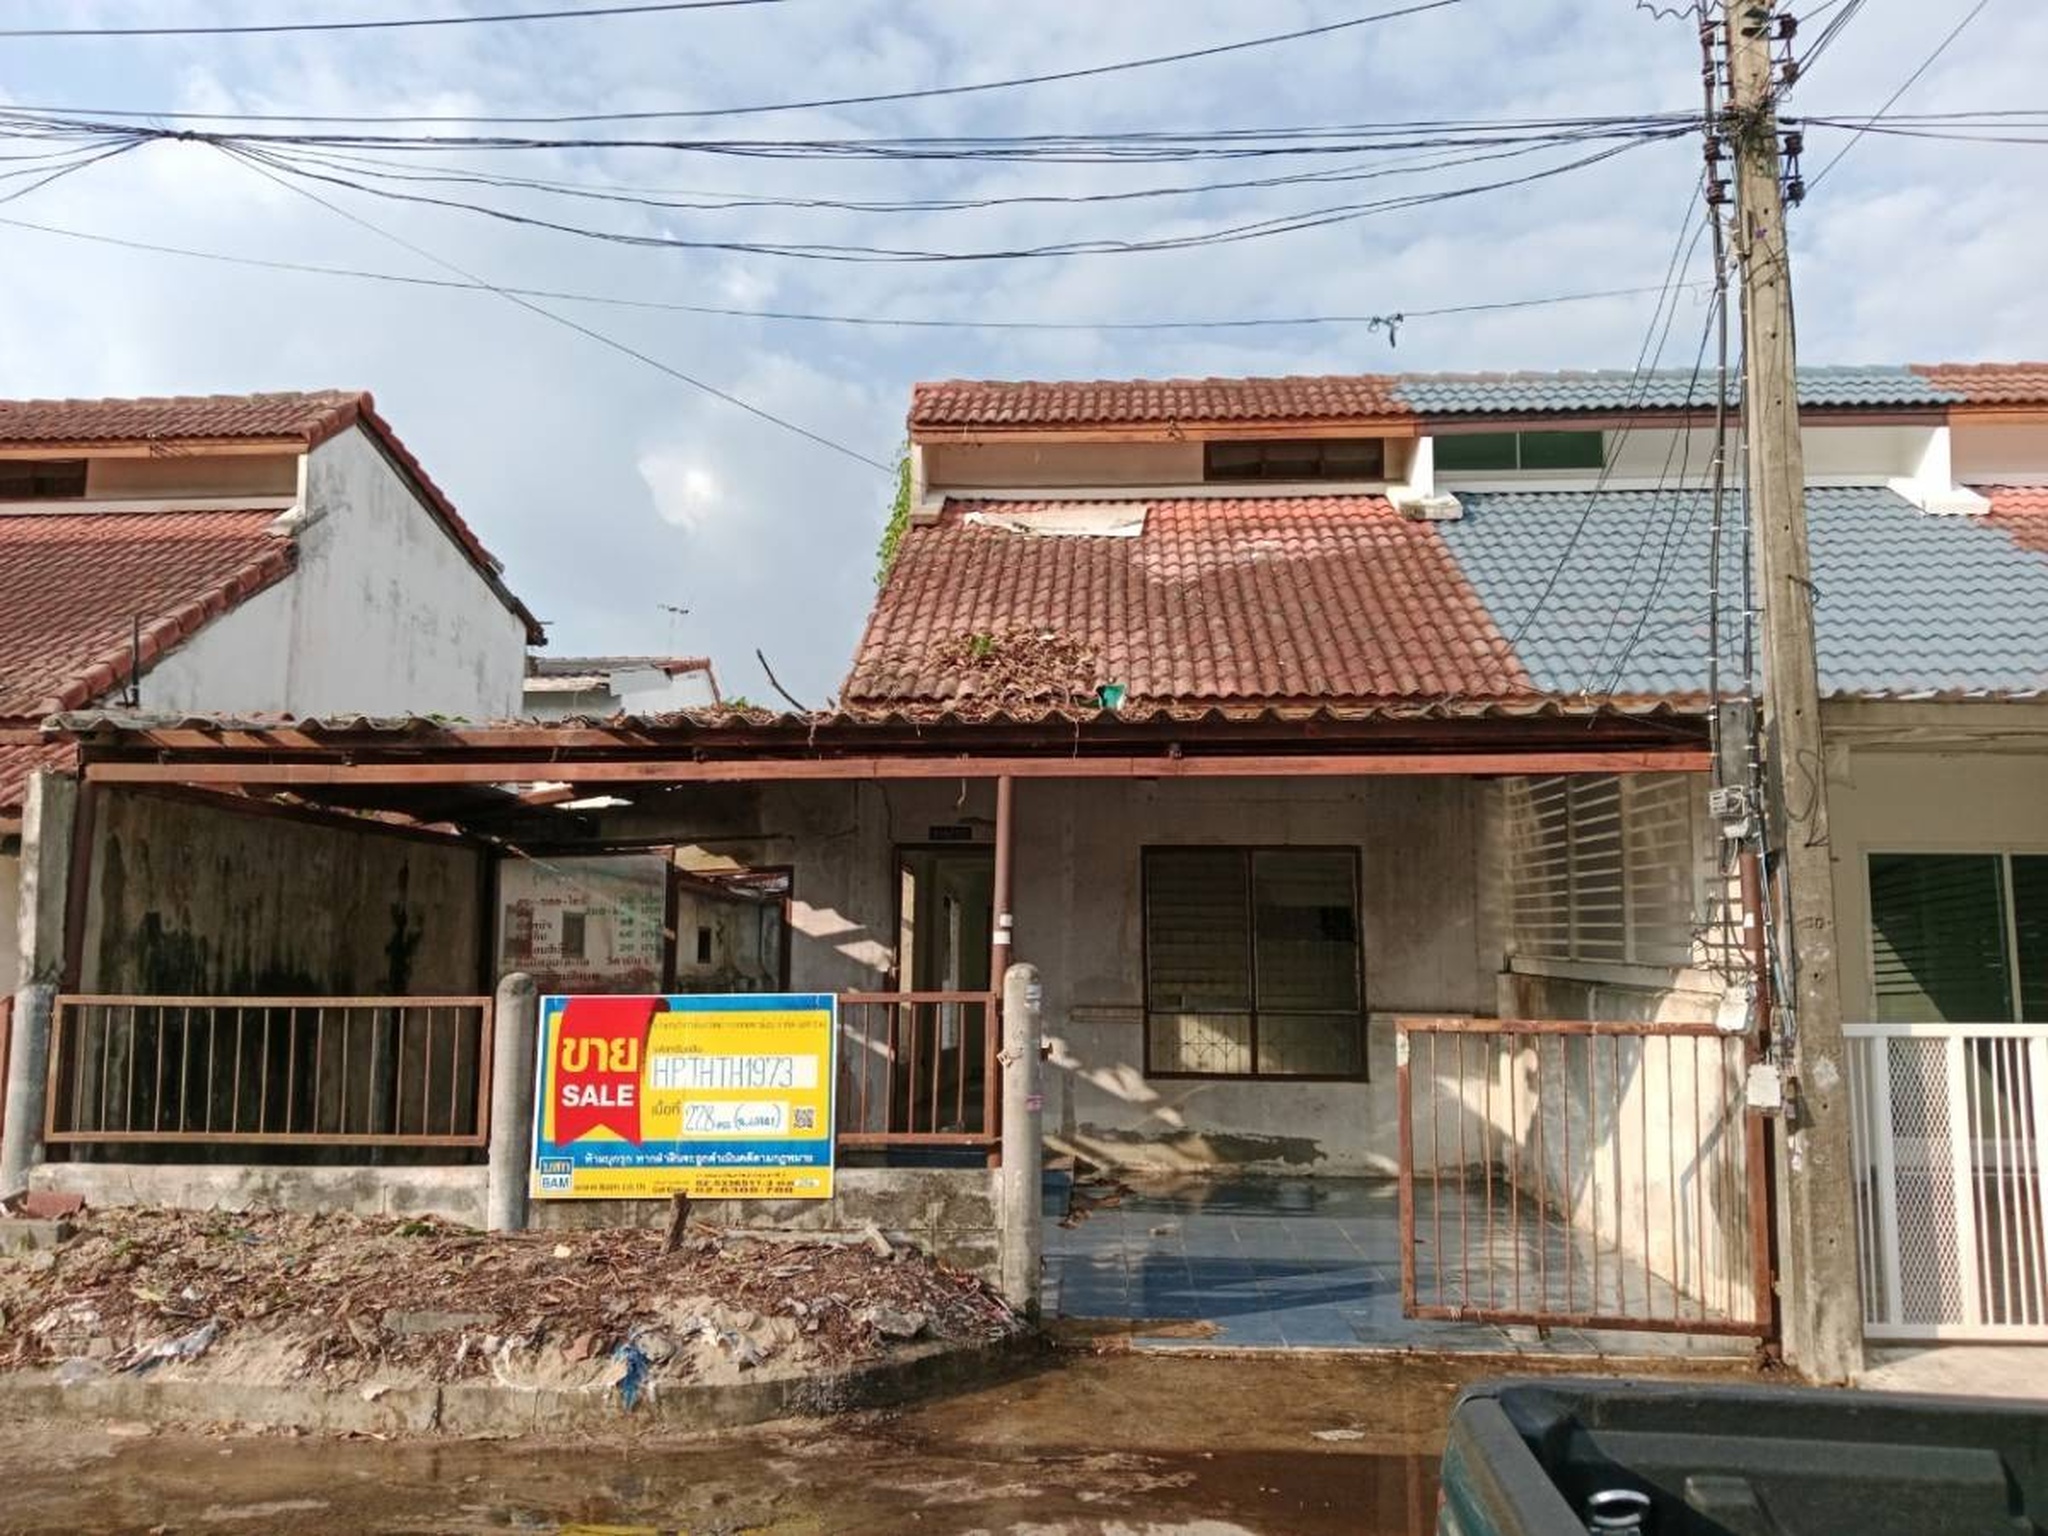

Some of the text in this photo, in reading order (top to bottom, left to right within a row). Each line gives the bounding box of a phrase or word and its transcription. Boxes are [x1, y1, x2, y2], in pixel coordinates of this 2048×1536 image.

[561, 1037, 639, 1073] ขาย
[562, 1084, 634, 1107] SALE
[543, 1177, 569, 1188] BAM
